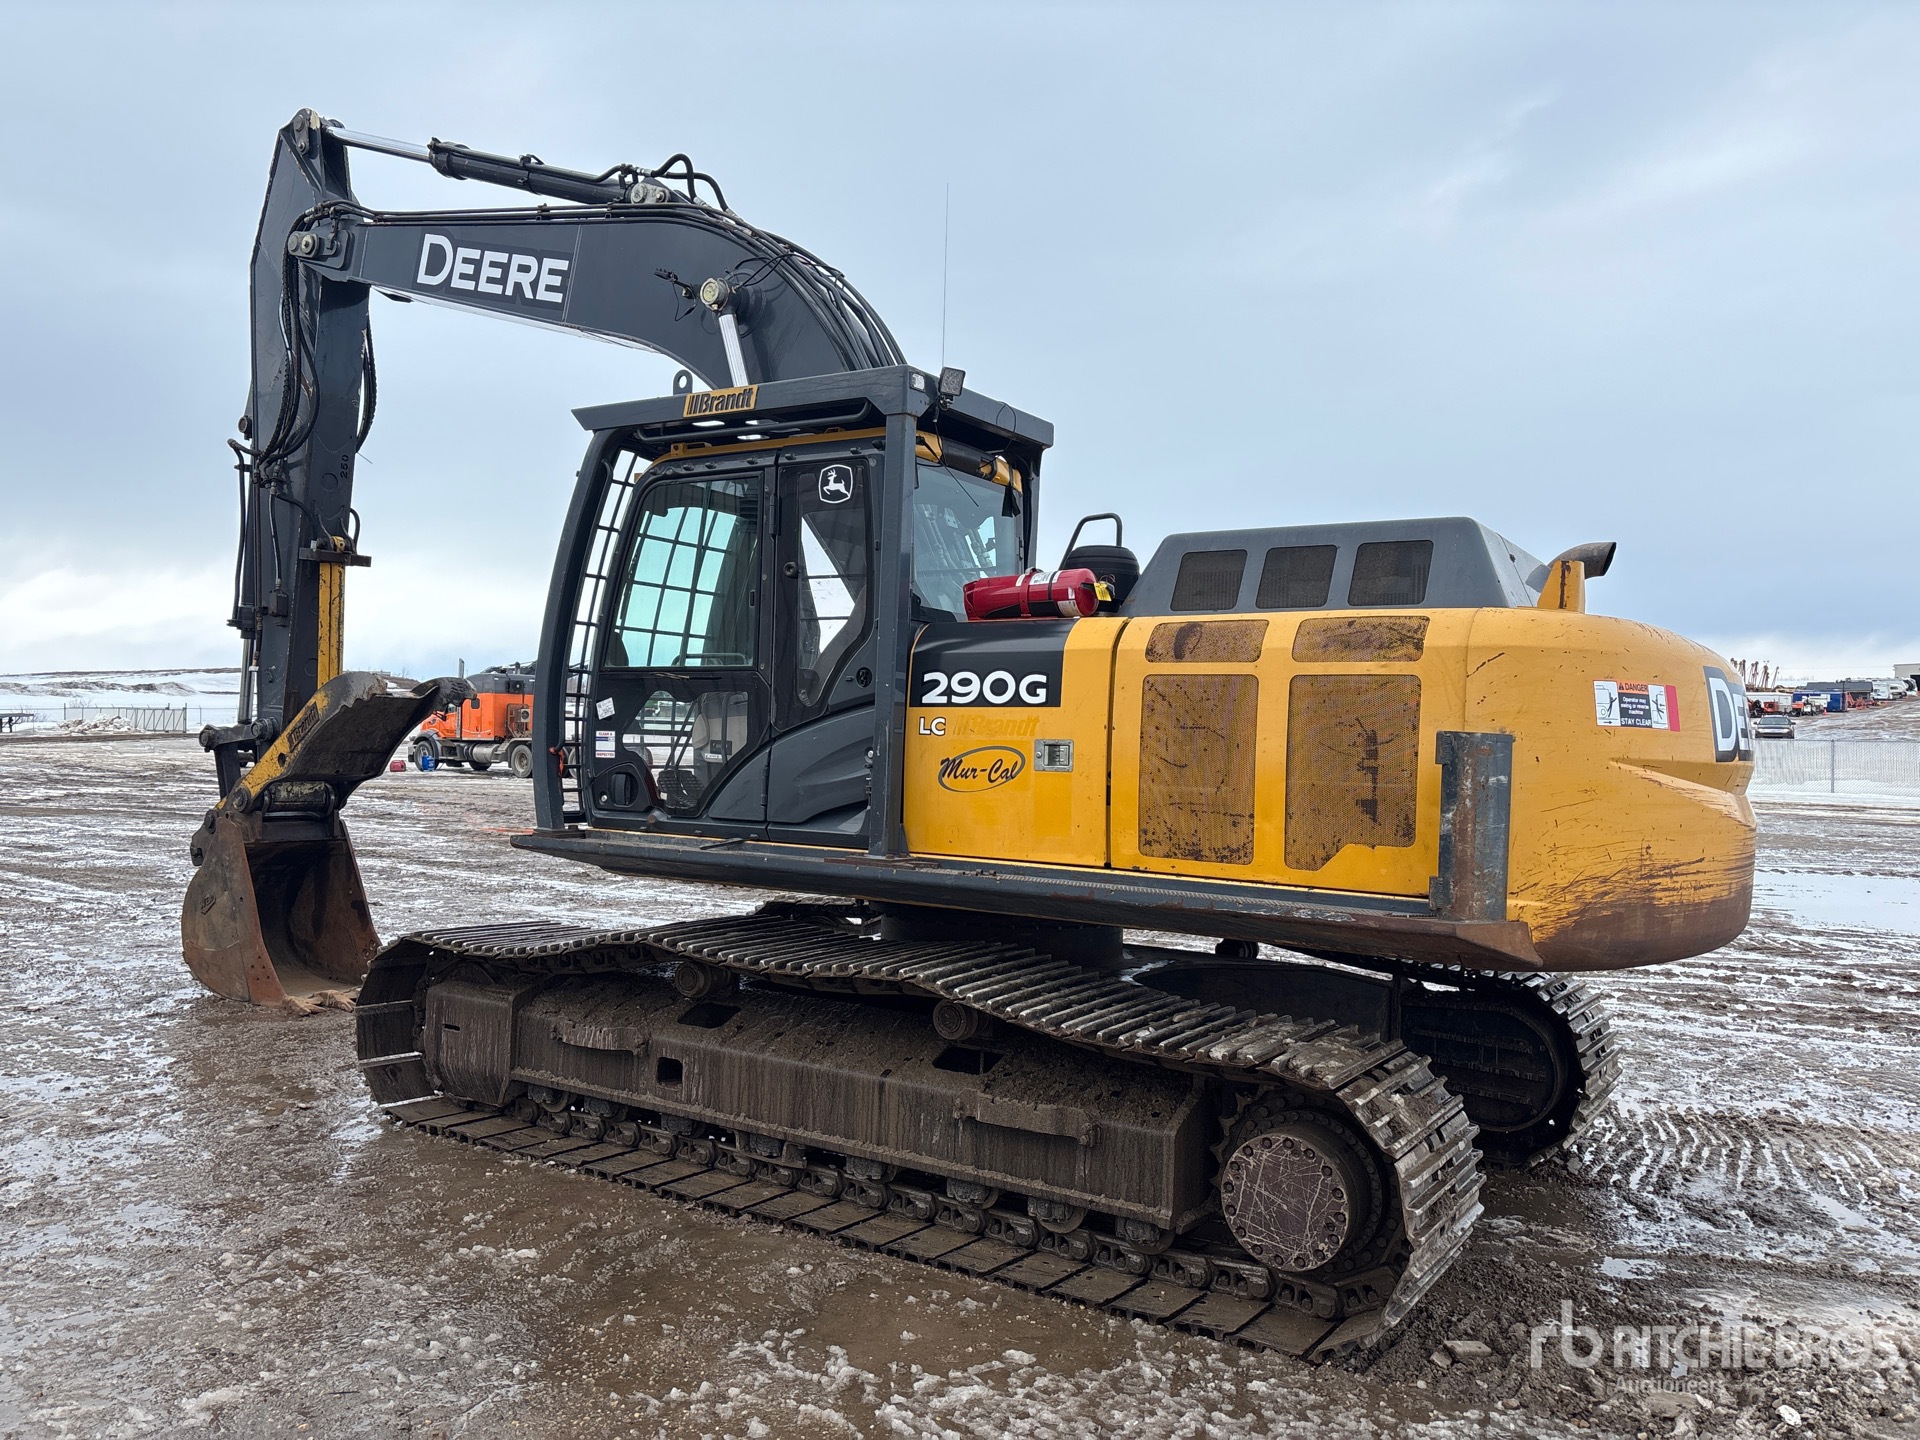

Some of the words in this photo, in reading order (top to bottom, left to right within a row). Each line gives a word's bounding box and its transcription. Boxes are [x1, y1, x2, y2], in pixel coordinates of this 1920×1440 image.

[416, 233, 570, 303] DEERE
[695, 387, 754, 414] Brandt
[921, 670, 1047, 704] 290G
[1625, 682, 1648, 692] DANGER
[1622, 696, 1639, 704] Operator
[918, 717, 946, 736] LC
[1621, 717, 1635, 725] STAY
[1635, 718, 1652, 726] CLEAR
[940, 757, 1018, 783] Mur-Cal
